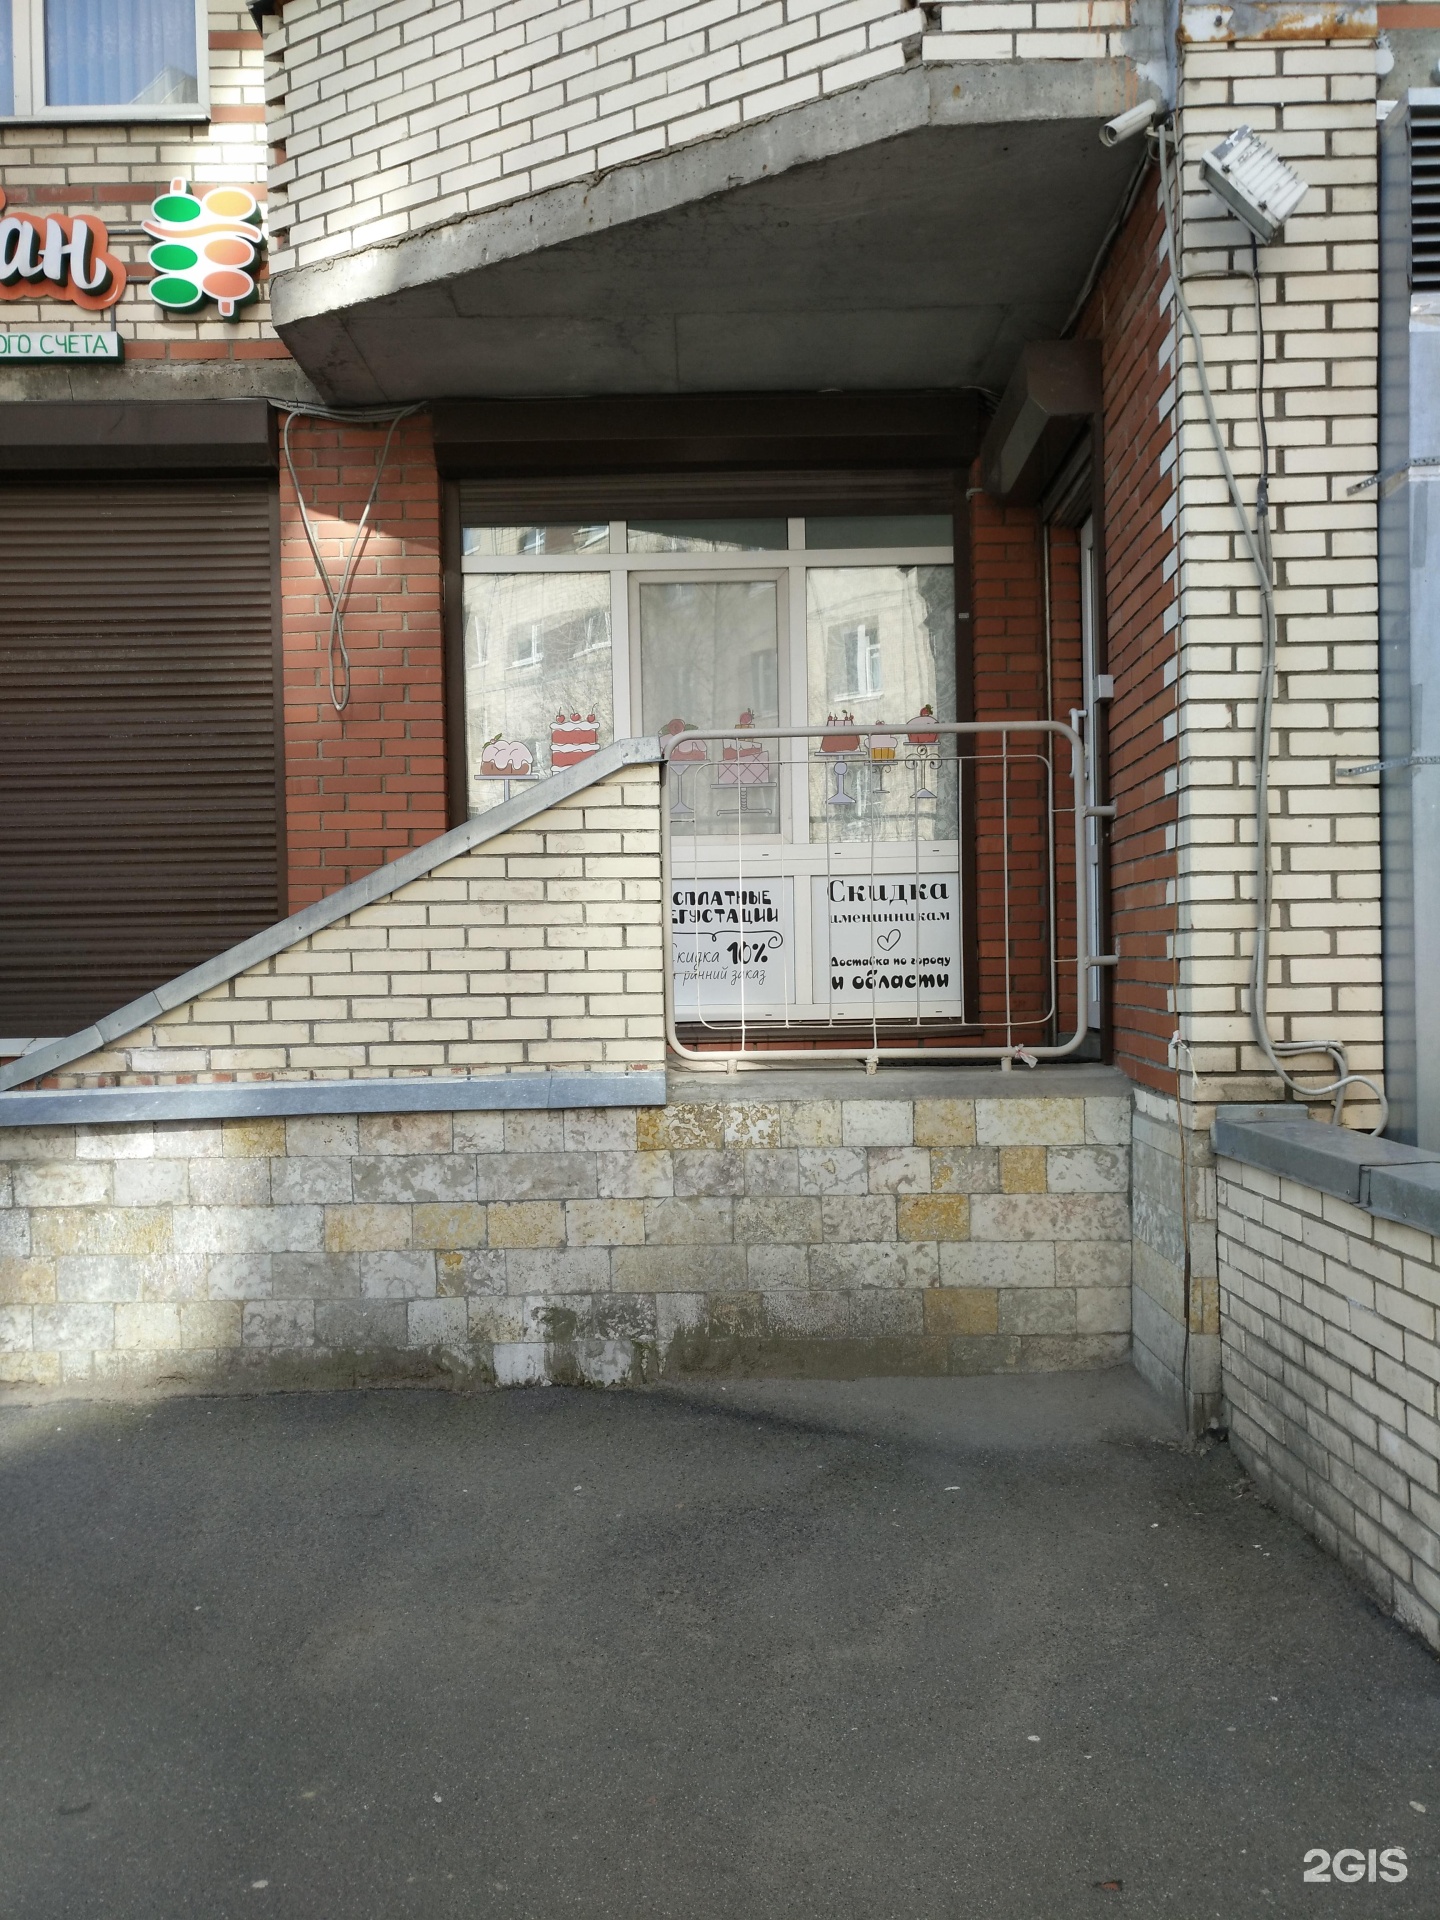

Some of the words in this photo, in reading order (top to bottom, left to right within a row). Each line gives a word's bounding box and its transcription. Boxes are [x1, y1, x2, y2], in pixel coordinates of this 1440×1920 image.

[39, 334, 108, 354] СЧЕТА
[827, 880, 950, 906] Скидка
[830, 911, 950, 924] именинникам
[673, 943, 720, 970] кидка
[726, 941, 768, 965] 10%
[893, 957, 907, 966] по
[831, 976, 844, 990] и
[852, 969, 949, 990] области
